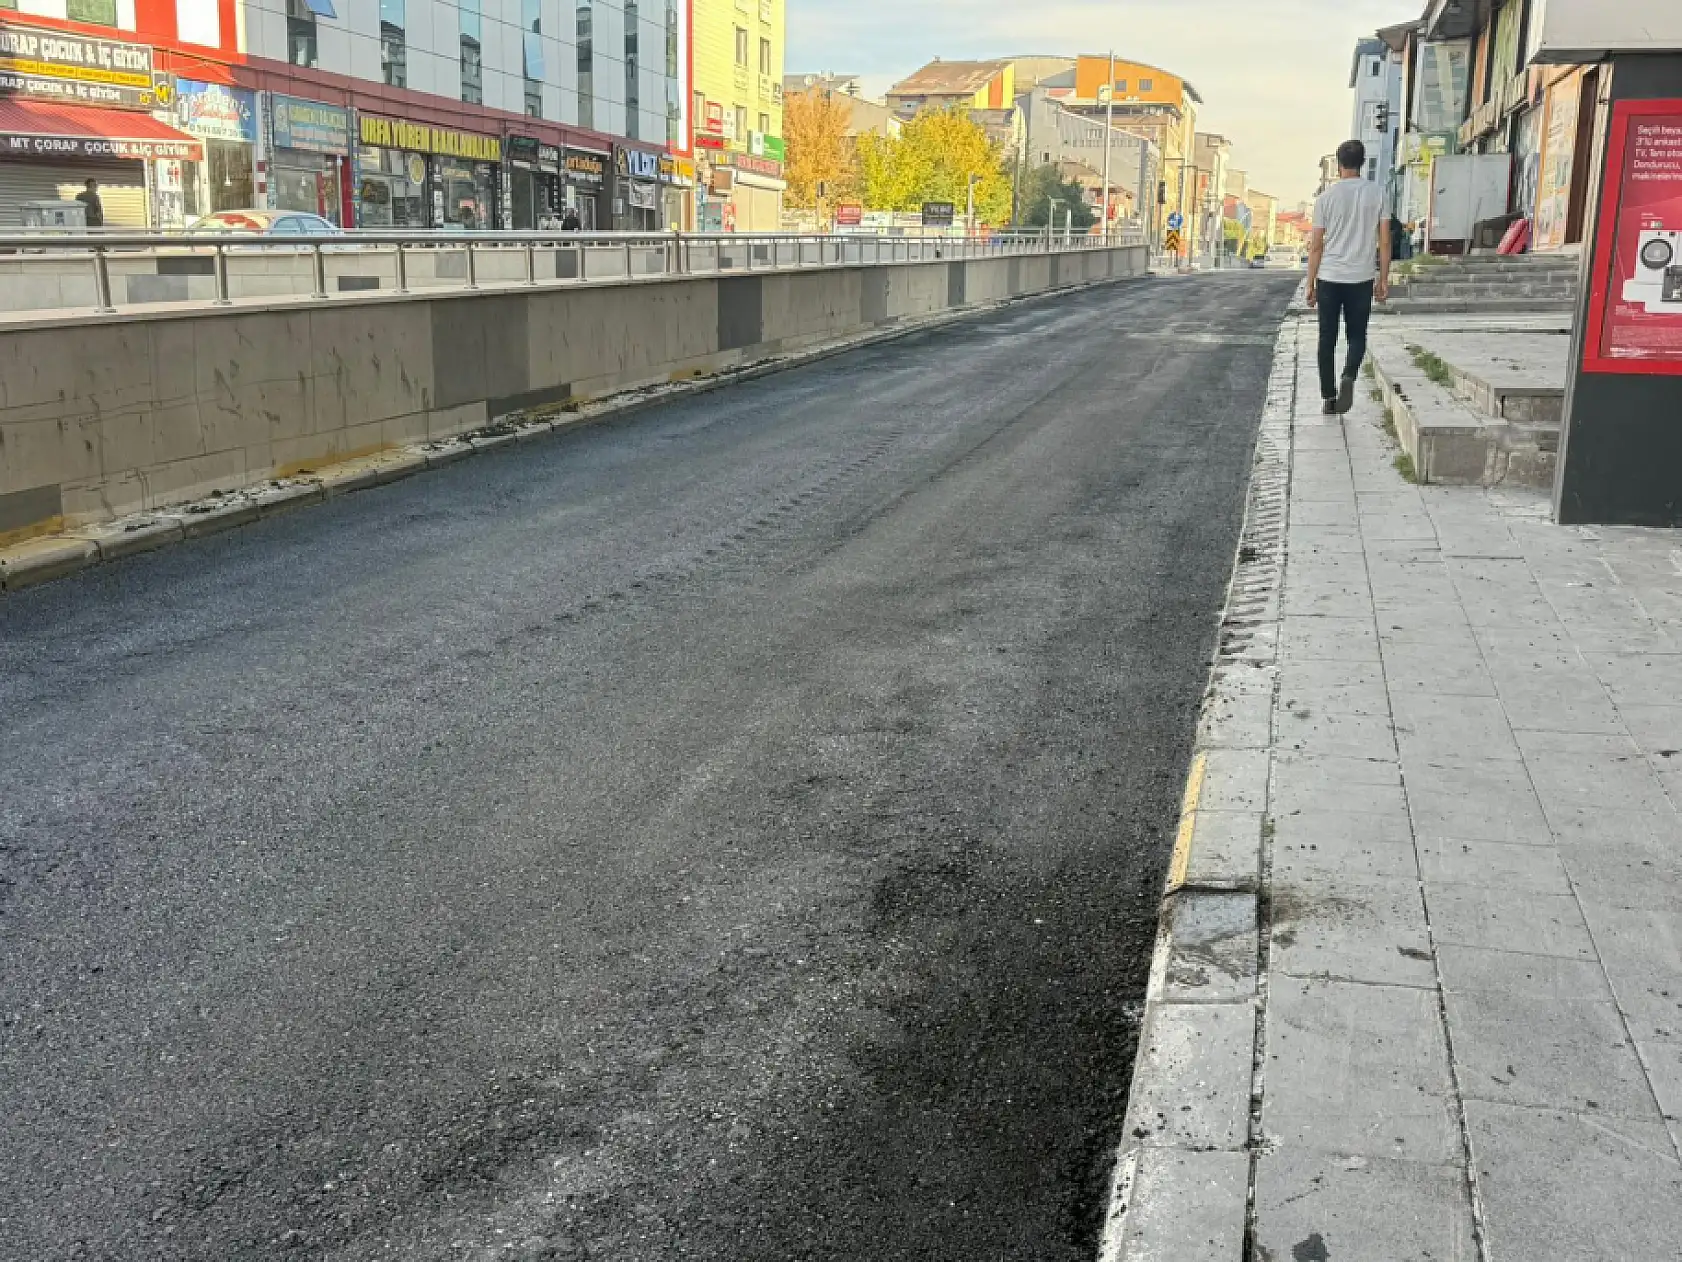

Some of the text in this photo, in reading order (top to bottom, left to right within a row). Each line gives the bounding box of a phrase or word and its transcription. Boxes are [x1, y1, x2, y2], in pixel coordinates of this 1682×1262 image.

[40, 37, 84, 61] ÇOCUK
[113, 47, 150, 71] GİYİM
[27, 79, 63, 93] ÇOCUK
[10, 137, 30, 149] MT
[34, 138, 79, 155] ÇORAP
[85, 141, 128, 156] ÇOCUK
[154, 141, 189, 156] GİYİM
[1654, 136, 1682, 147] ankast
